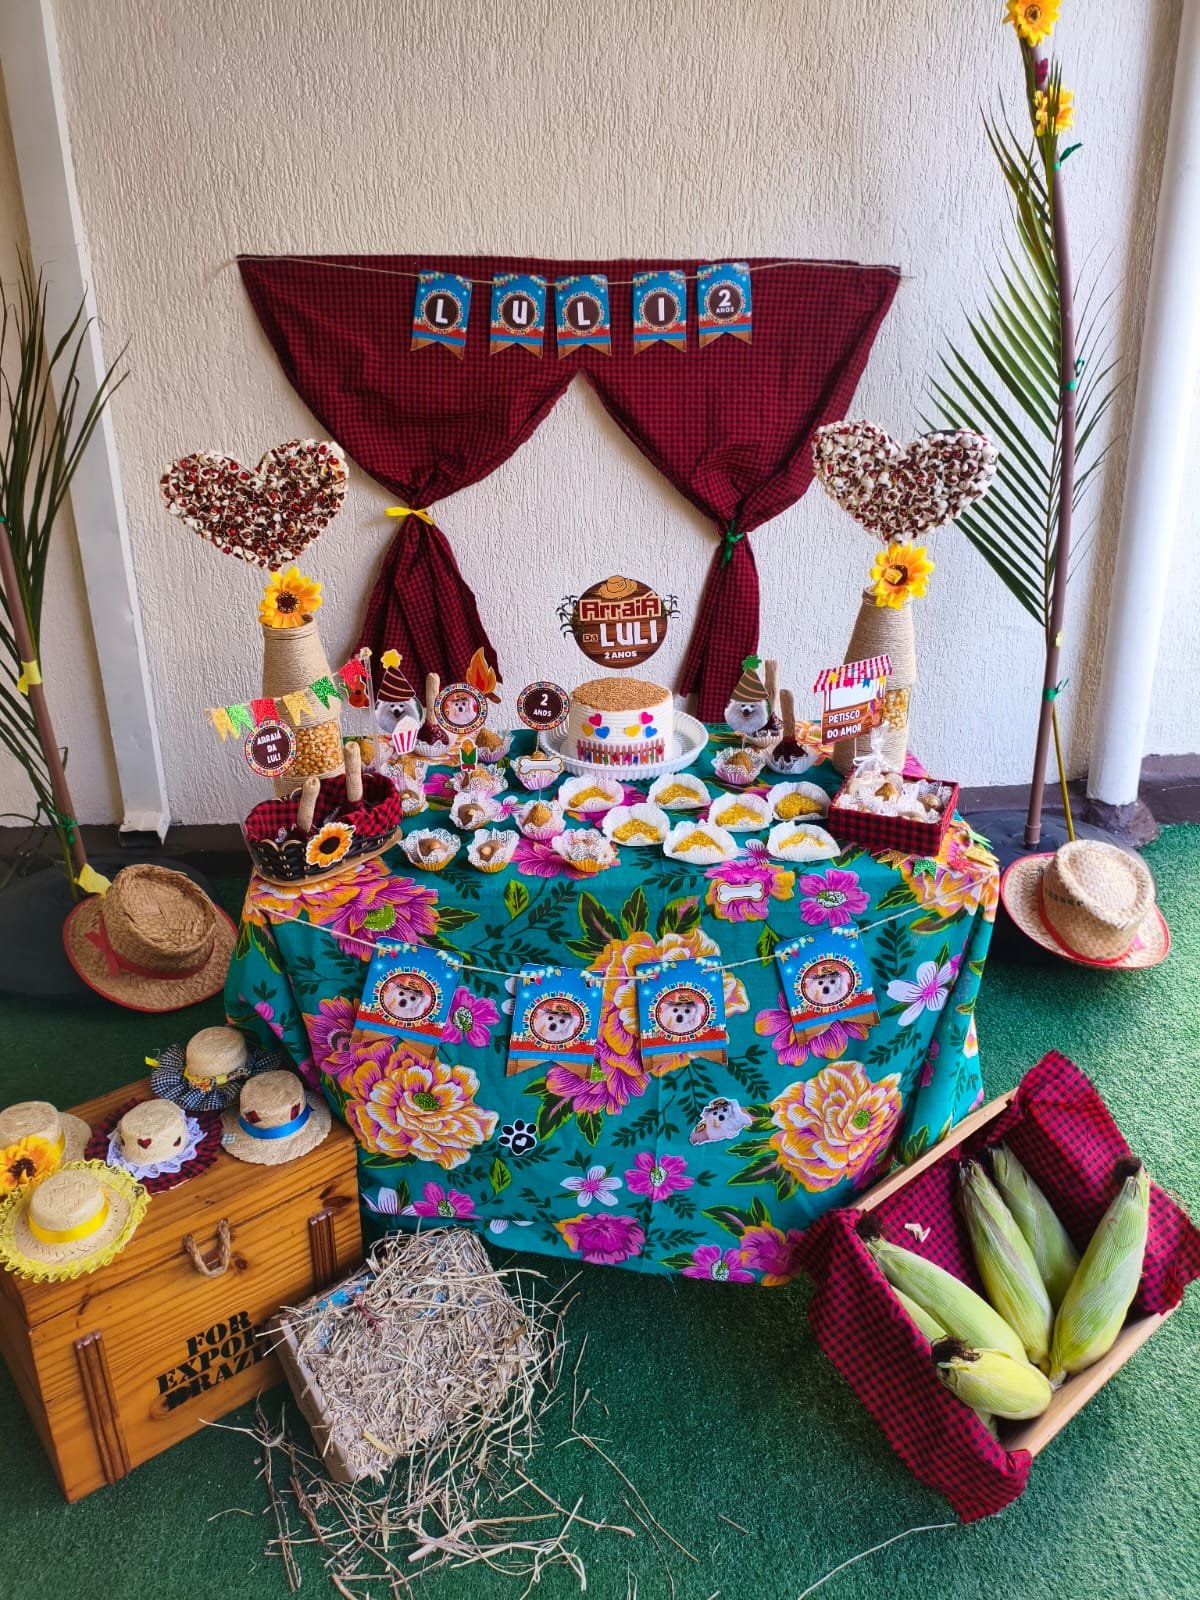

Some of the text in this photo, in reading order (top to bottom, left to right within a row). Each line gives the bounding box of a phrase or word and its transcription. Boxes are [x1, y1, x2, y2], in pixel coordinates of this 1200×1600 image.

[718, 289, 732, 307] 2
[435, 298, 665, 326] L U L I
[715, 306, 735, 314] ANOS
[600, 620, 658, 647] LULI
[604, 650, 638, 659] 2 ANOS
[540, 693, 549, 706] 2
[533, 708, 552, 717] ANOS
[828, 709, 860, 724] PETISCO
[827, 723, 862, 739] DO AMOR
[266, 743, 278, 753] DA
[267, 752, 281, 764] LULI
[186, 1310, 252, 1359] FOR
